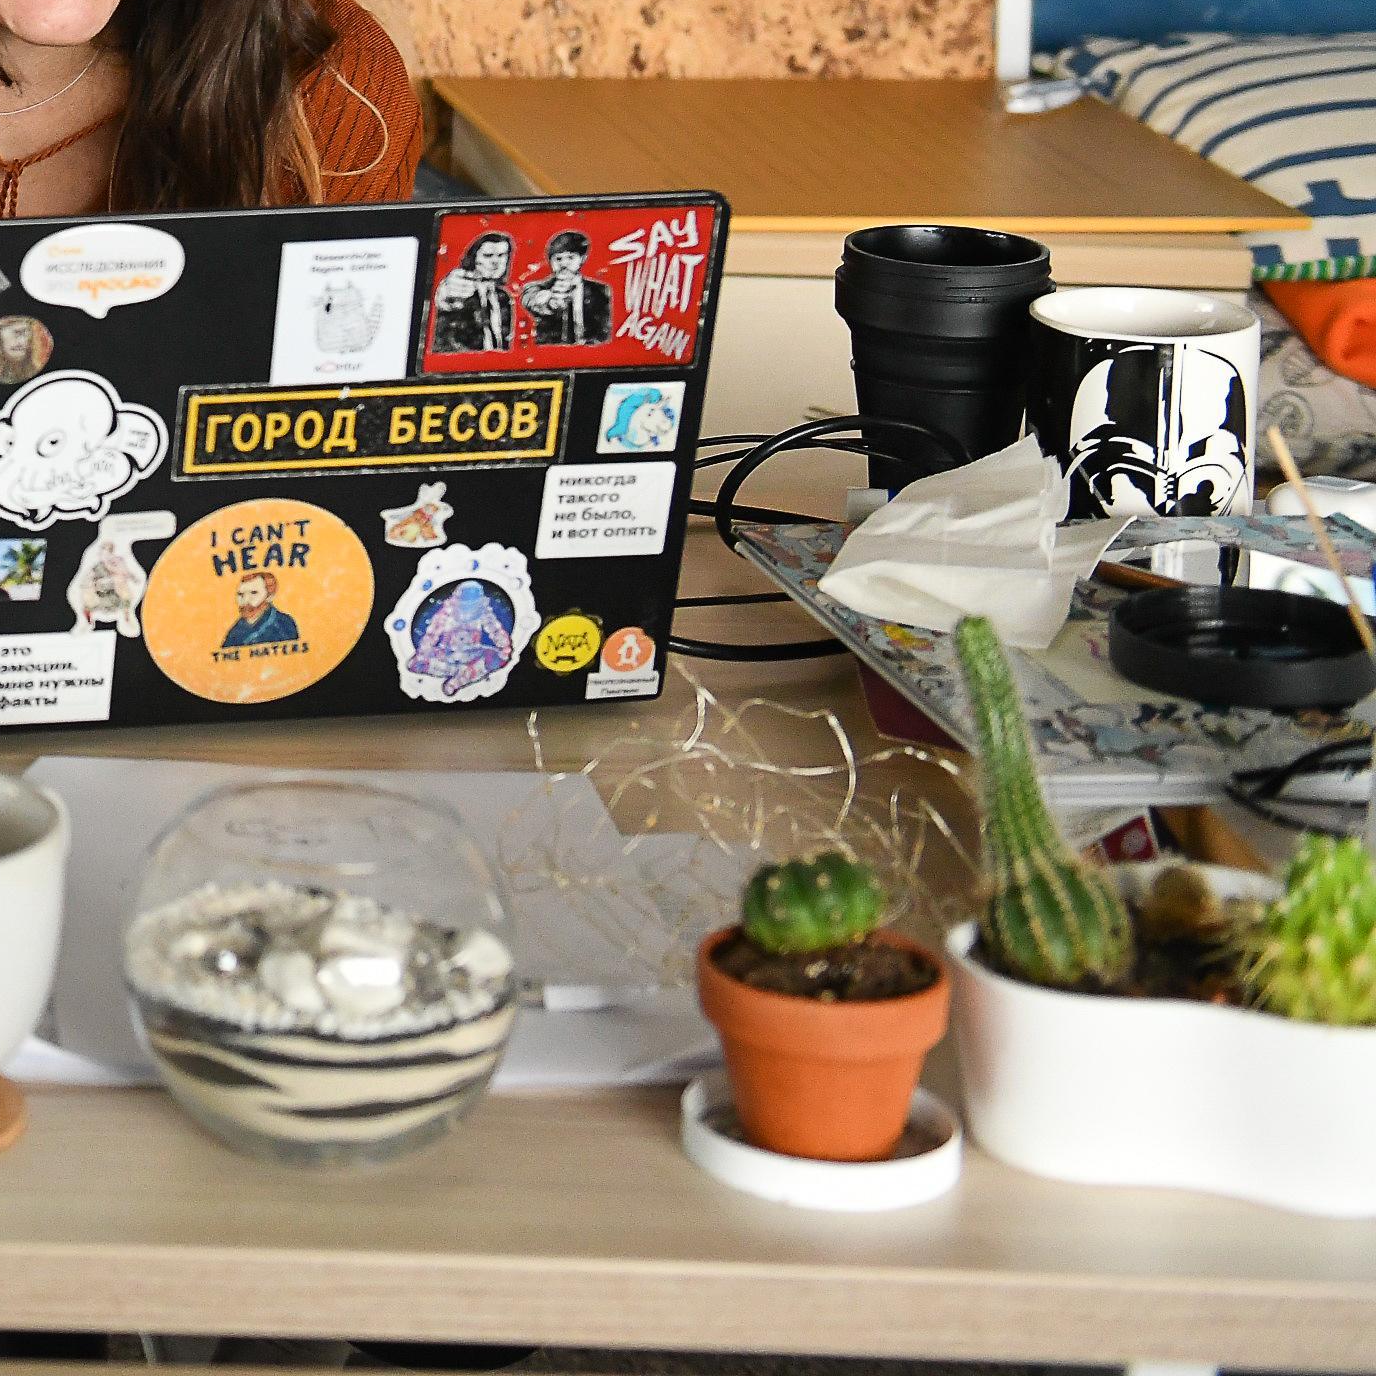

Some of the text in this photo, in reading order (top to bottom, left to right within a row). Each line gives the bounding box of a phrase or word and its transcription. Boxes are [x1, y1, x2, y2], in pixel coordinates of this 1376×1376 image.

[608, 210, 699, 265] SAY
[624, 252, 705, 319] WHAT
[616, 310, 691, 360] AGAIN
[204, 401, 540, 454] ГОРОД БЕСОВ
[559, 475, 637, 488] никогда
[558, 492, 620, 504] такого
[554, 507, 636, 522] не было,
[211, 520, 311, 547] I CAN'T
[551, 525, 658, 539] и вот опять
[212, 542, 311, 577] HEAR
[1, 646, 32, 657] это
[211, 642, 310, 662] THE HATERS
[39, 677, 105, 690] нужны
